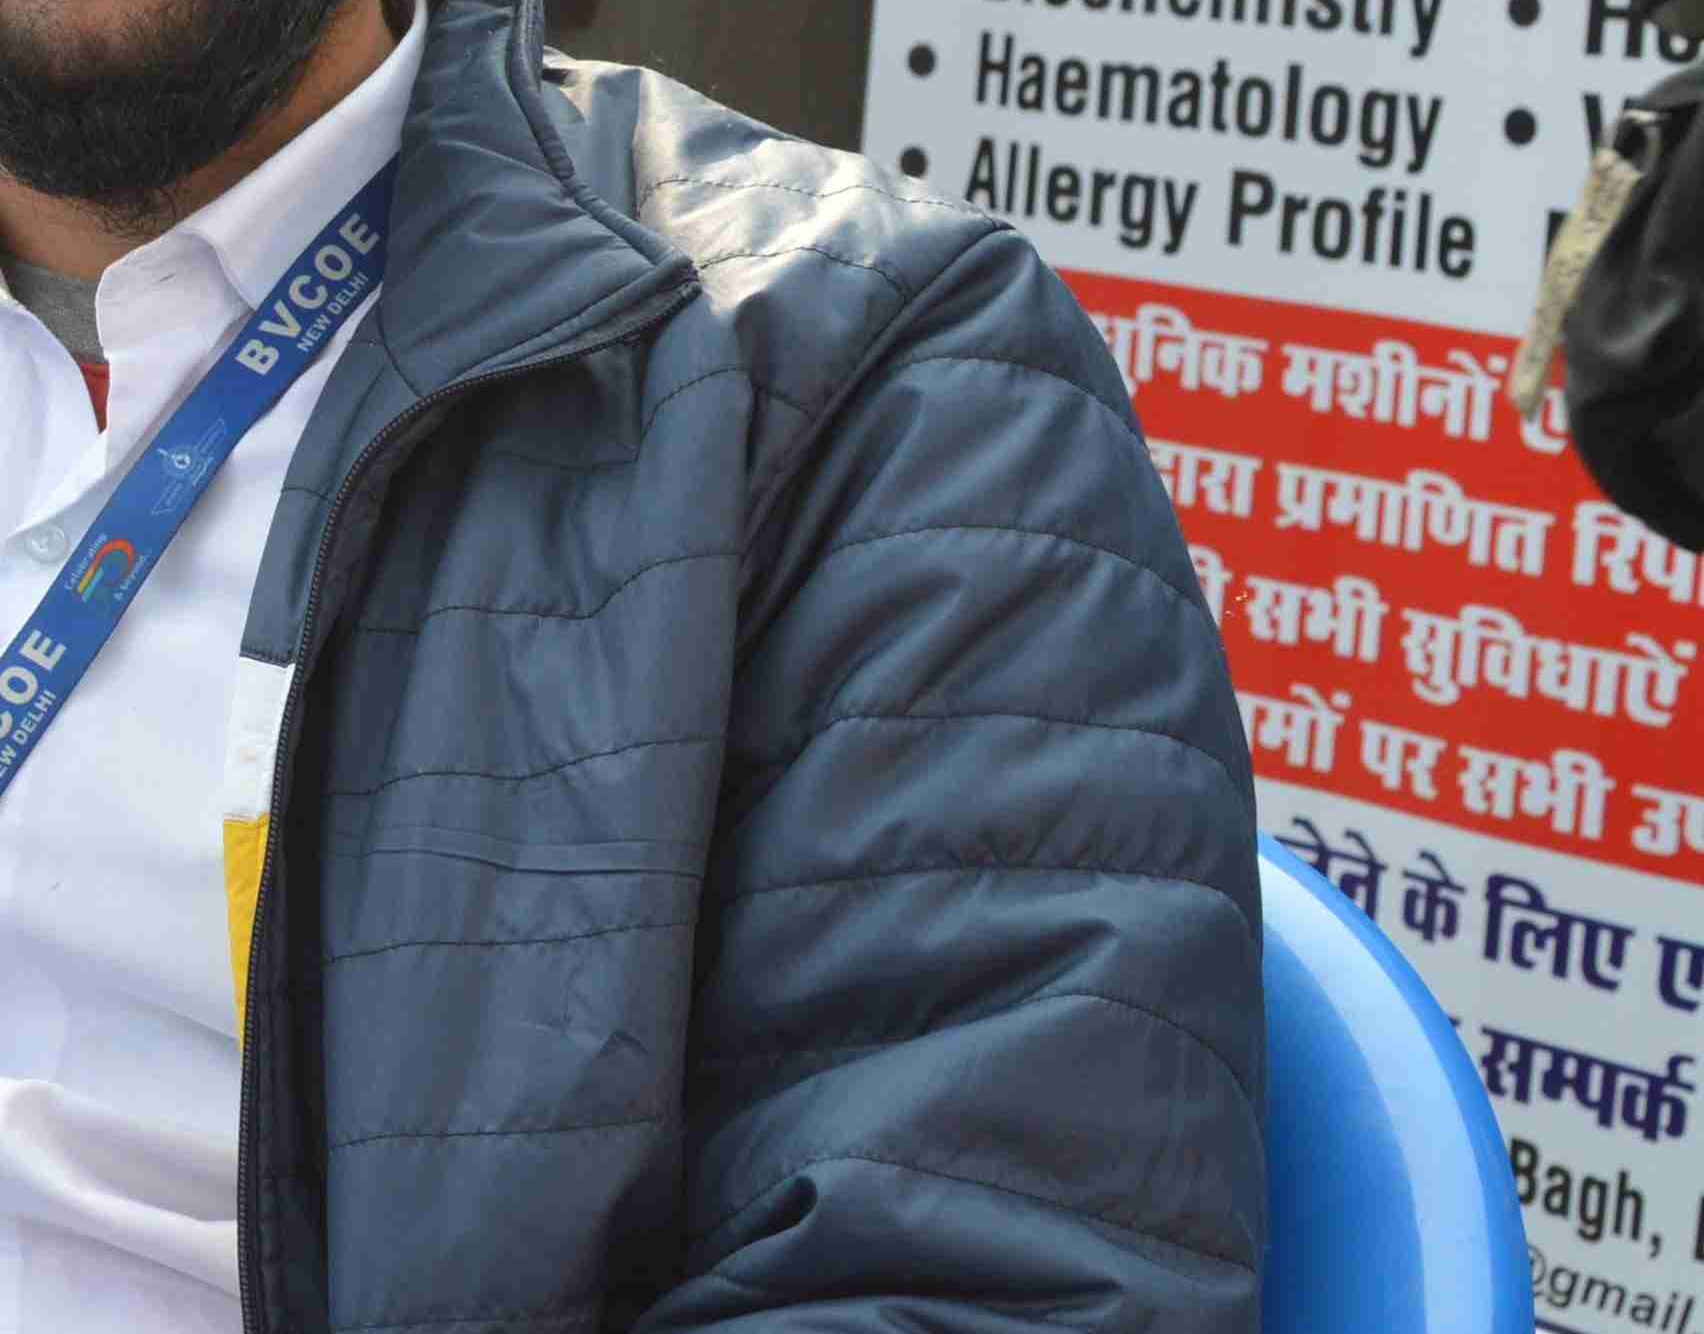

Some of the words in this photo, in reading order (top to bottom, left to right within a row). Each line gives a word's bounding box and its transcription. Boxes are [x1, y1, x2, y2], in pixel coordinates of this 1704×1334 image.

[973, 30, 1442, 174] Haematology
[965, 138, 1197, 257] Allergy
[1227, 171, 1475, 280] Profile
[235, 212, 380, 376] BVCOE
[296, 314, 333, 352] NEW
[327, 270, 369, 315] DELHI
[1281, 339, 1508, 442] मशीनों
[1274, 468, 1555, 578] प्रमाणित
[1245, 575, 1389, 663] सभी
[12, 689, 57, 745] DELHI
[1359, 718, 1448, 802] पर
[1456, 746, 1617, 841] सभी
[1403, 850, 1467, 943] के
[1483, 872, 1636, 993] लिए
[1480, 1024, 1695, 1143] सम्पर्क
[1509, 1136, 1662, 1259] Bagh,
